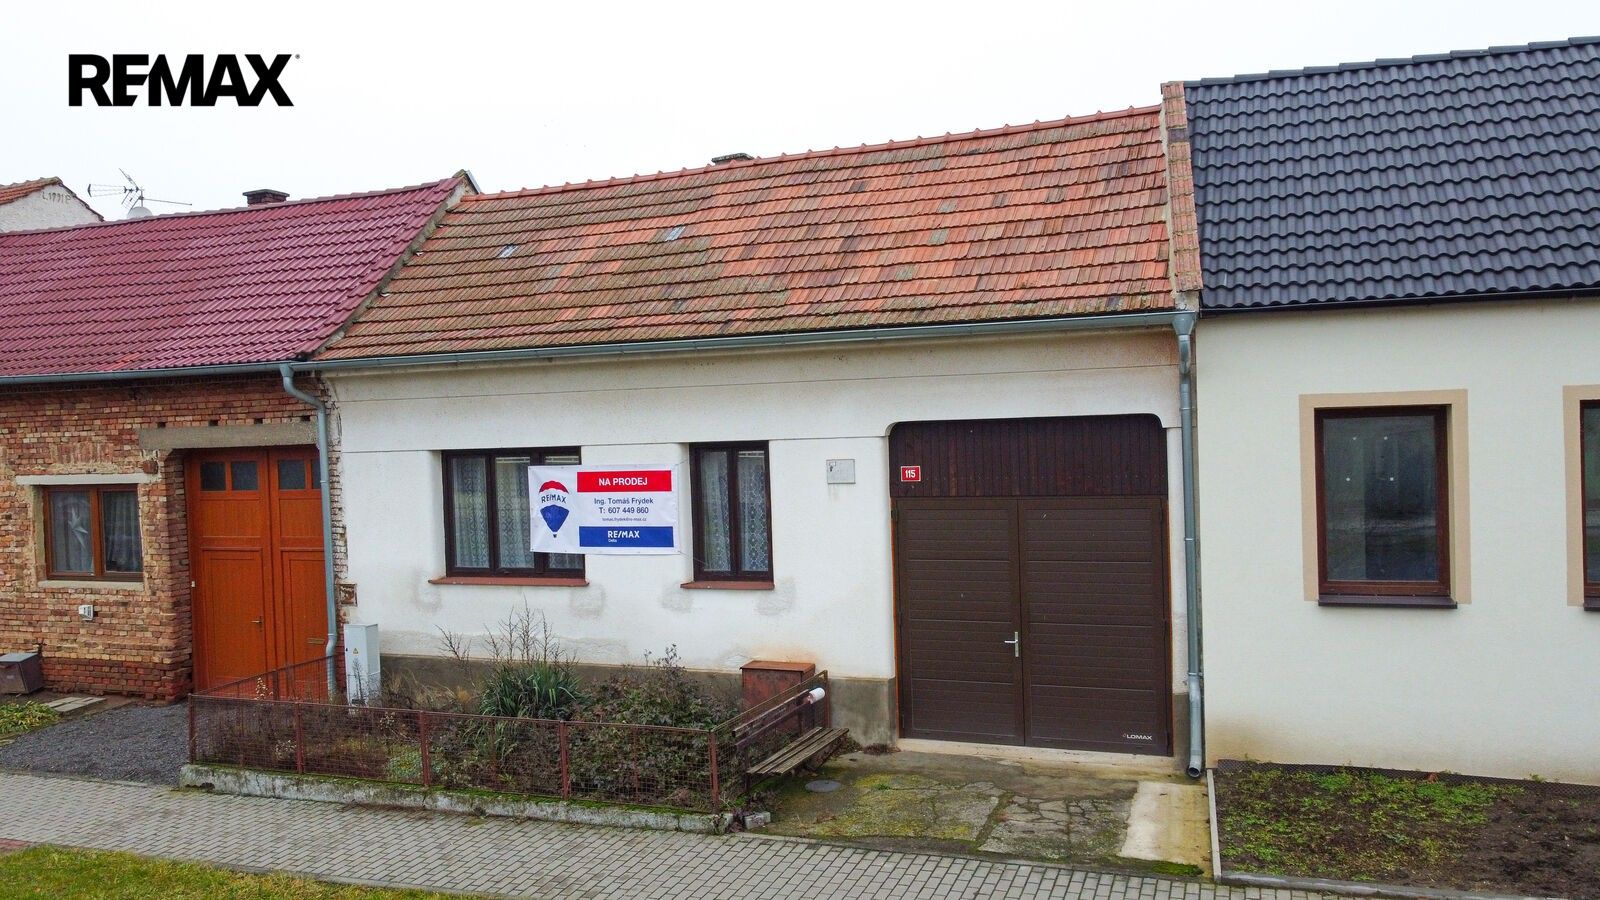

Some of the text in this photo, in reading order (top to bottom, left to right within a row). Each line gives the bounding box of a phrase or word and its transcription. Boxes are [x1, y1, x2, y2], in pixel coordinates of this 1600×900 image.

[905, 469, 916, 478] 115
[598, 477, 648, 486] NA PRODEJ
[541, 494, 567, 504] RE/MAX
[594, 497, 606, 505] Ing.
[631, 497, 654, 505] Frýdek
[599, 506, 649, 514] T: 607 449 860
[607, 530, 640, 538] RE/MAX
